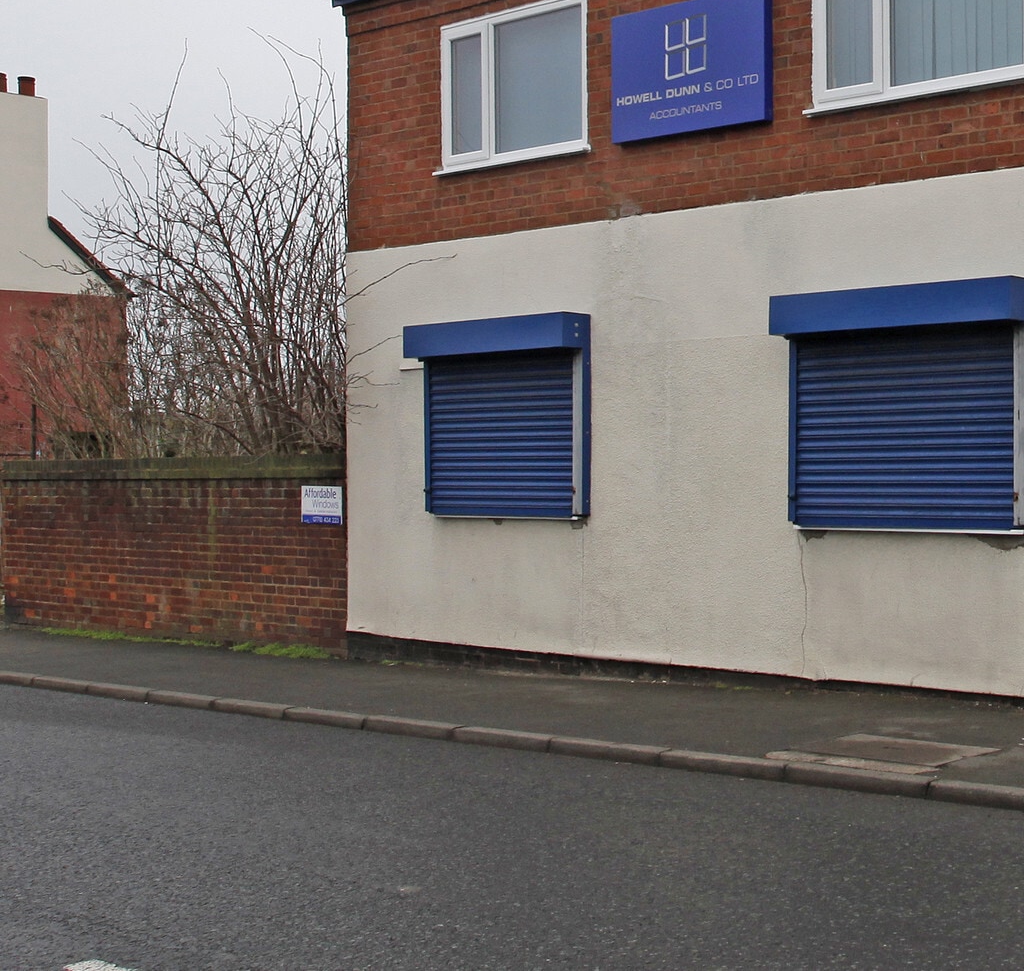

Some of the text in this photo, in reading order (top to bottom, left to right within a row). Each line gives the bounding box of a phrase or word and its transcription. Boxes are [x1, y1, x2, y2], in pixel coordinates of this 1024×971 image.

[616, 73, 759, 107] HOWELL DUNN & CO LTD
[649, 100, 722, 121] ACCOUNTANTS
[303, 487, 337, 499] Affordable
[311, 499, 339, 509] Windows
